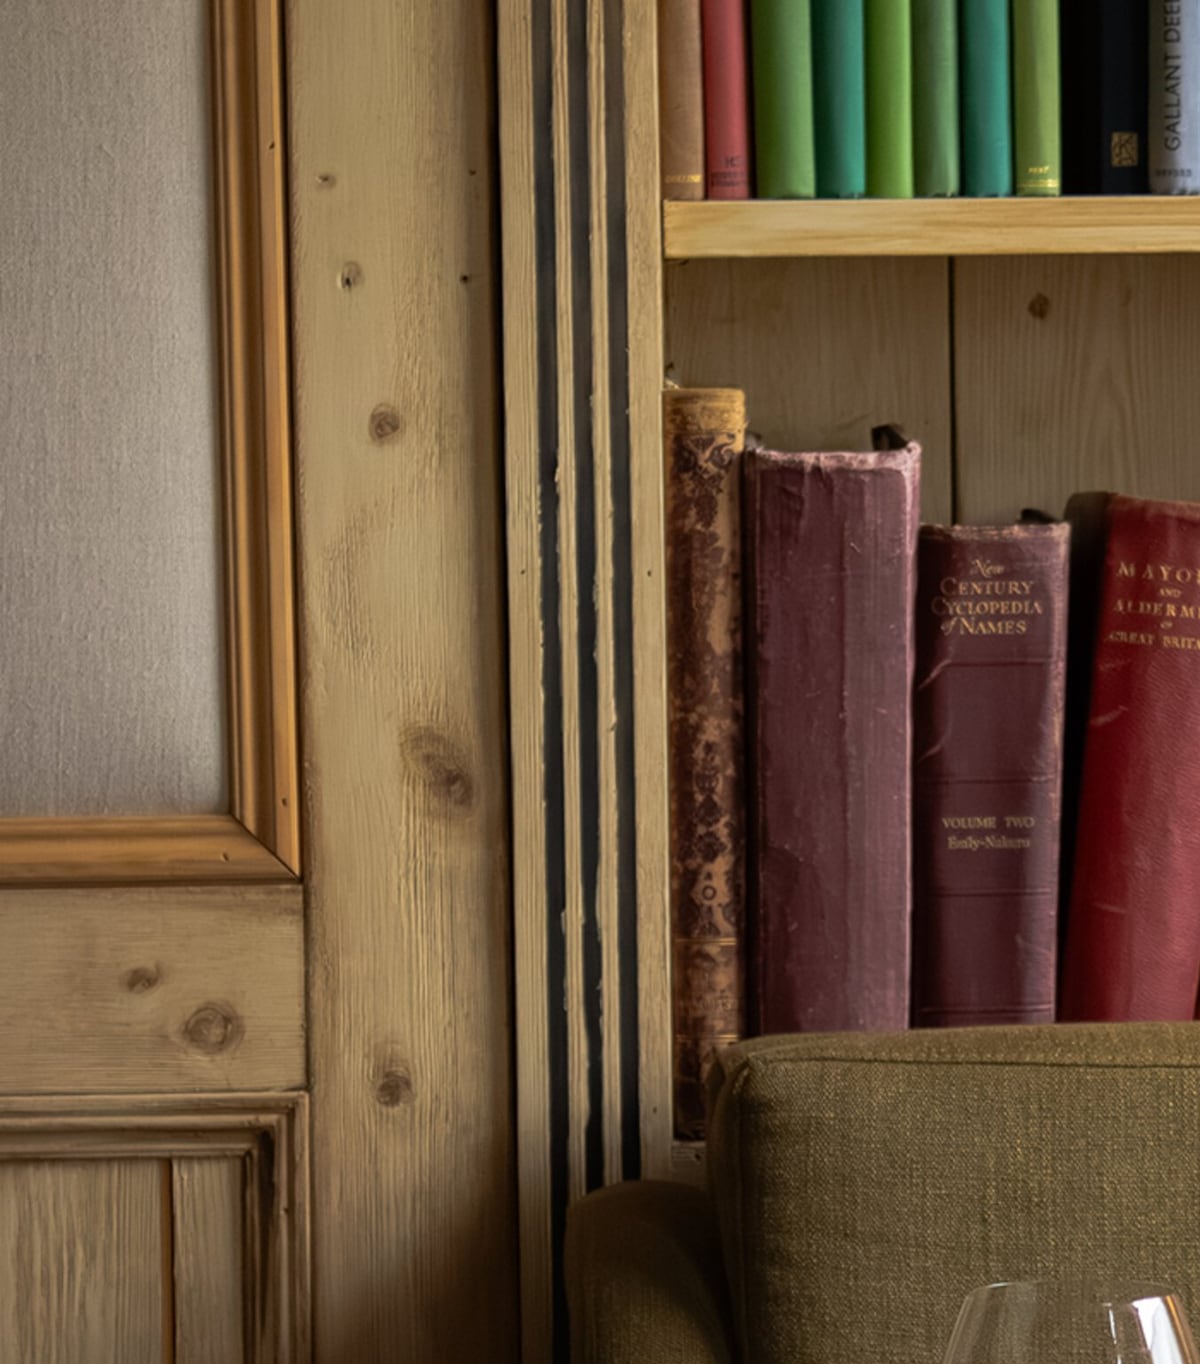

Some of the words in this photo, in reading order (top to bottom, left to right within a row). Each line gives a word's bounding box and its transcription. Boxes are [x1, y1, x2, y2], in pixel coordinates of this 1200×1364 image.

[1164, 0, 1181, 42] DEE
[1164, 53, 1181, 151] GALLANT
[973, 558, 1004, 578] New
[1160, 587, 1182, 598] AND
[942, 816, 997, 829] VOLUME
[1004, 816, 1035, 829] TWO
